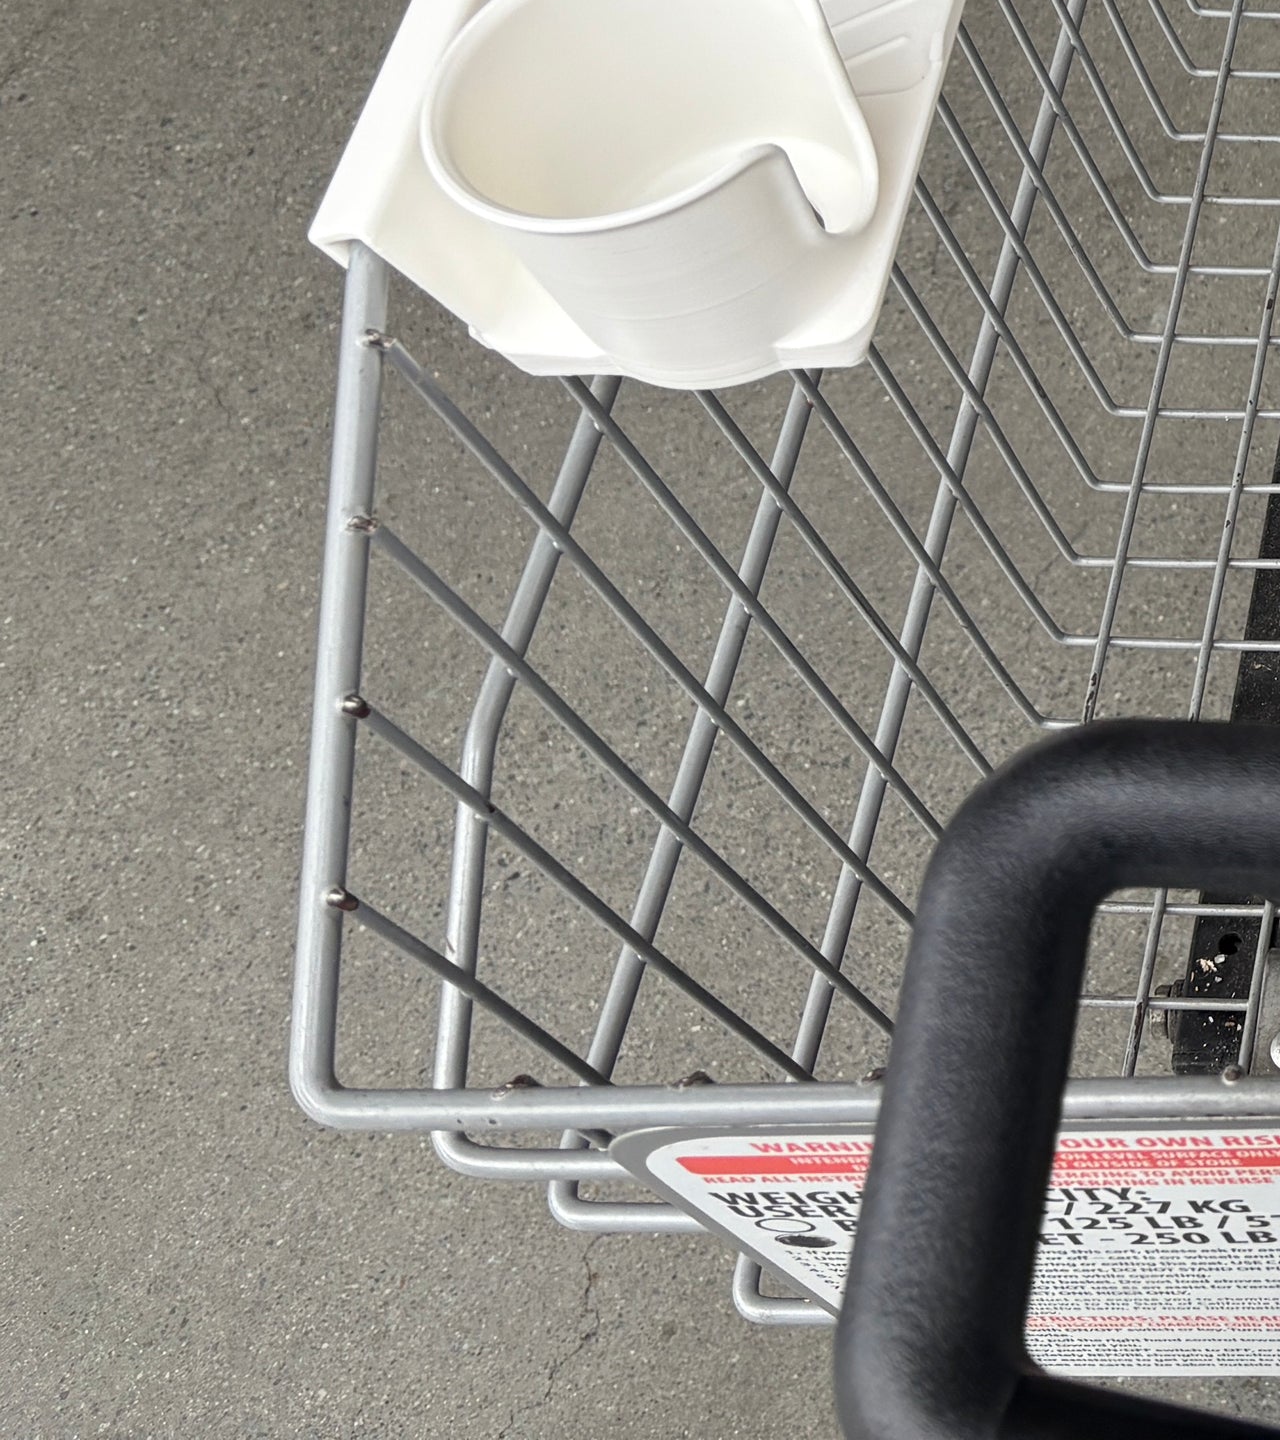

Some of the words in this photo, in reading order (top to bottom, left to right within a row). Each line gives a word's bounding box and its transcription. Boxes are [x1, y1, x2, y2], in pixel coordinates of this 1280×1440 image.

[1135, 1136, 1214, 1147] OWN
[1151, 1151, 1232, 1159] SURFACE
[1073, 1160, 1152, 1168] OUTSIDE
[727, 1205, 857, 1218] USER
[1088, 1201, 1171, 1214] 227
[1188, 1200, 1251, 1213] KG
[1049, 1217, 1134, 1230] 125
[1144, 1216, 1203, 1229] LB
[1124, 1232, 1210, 1244] 250
[1221, 1231, 1277, 1244] LB
